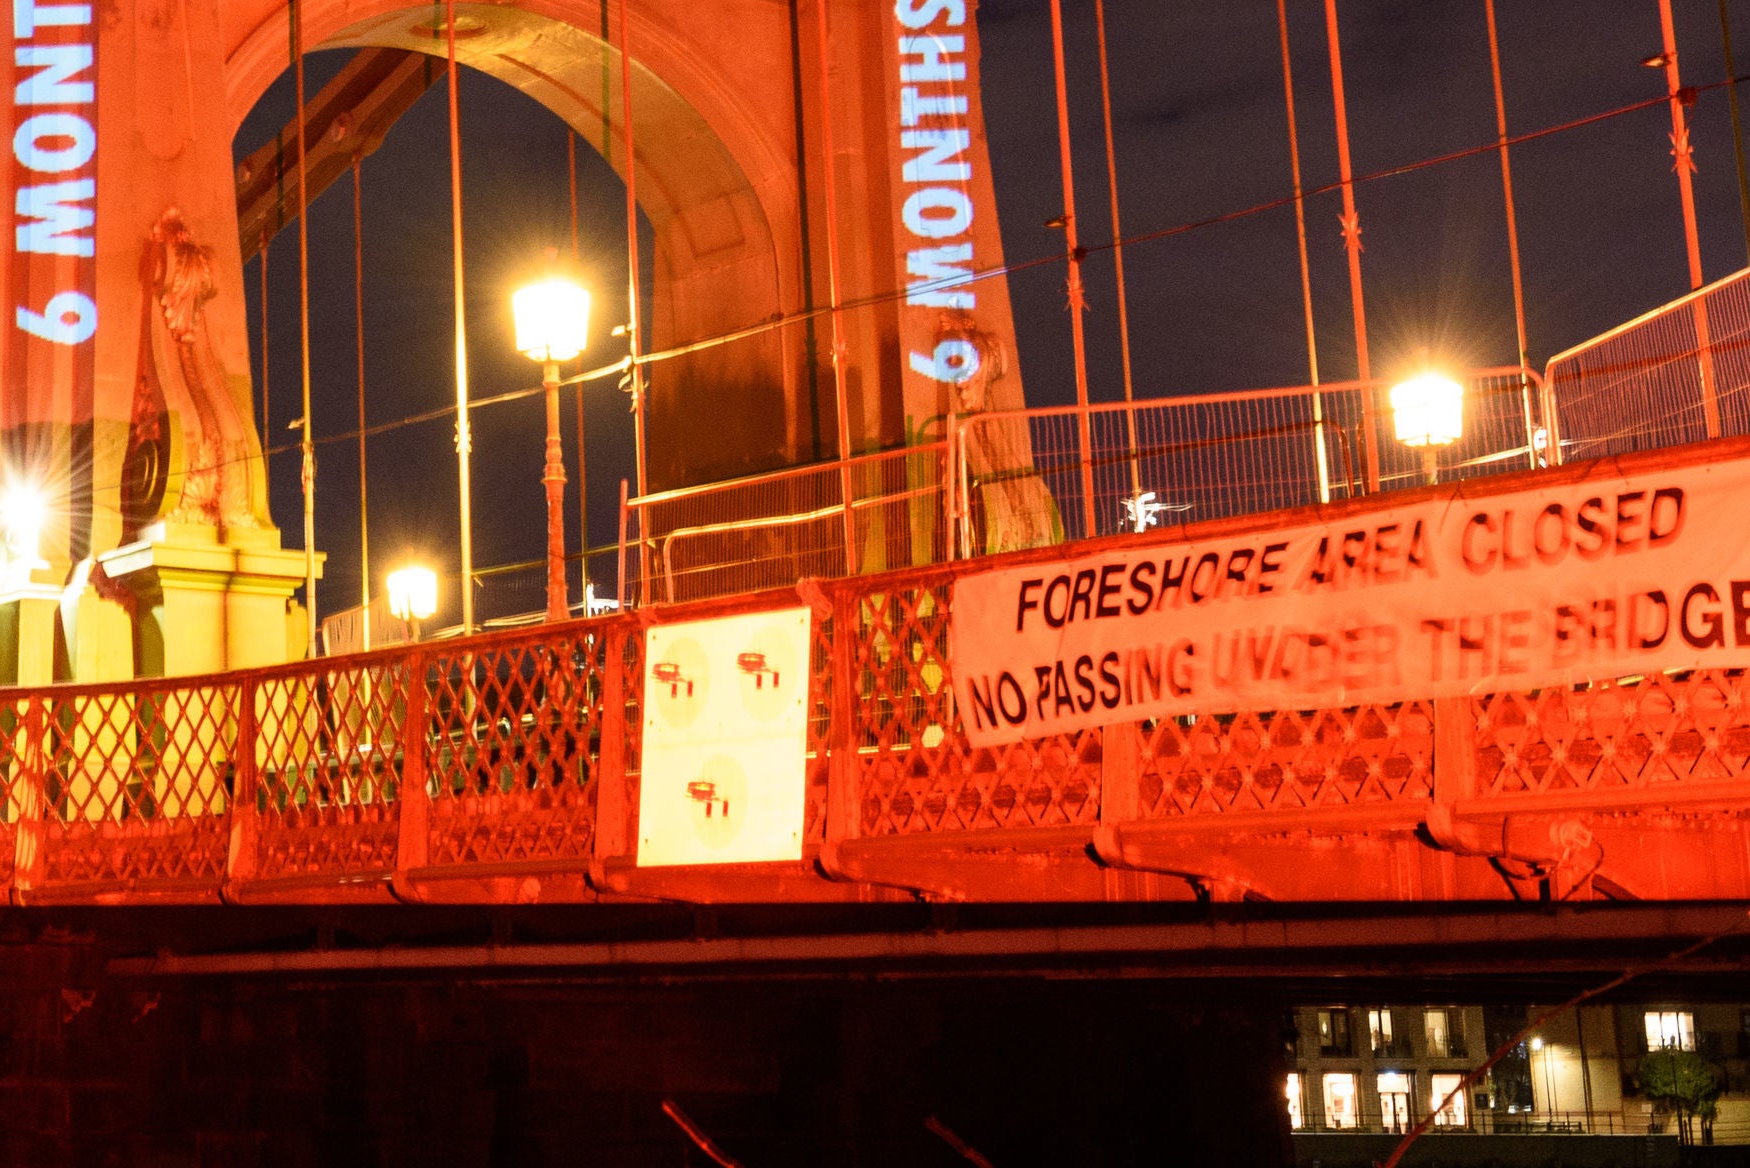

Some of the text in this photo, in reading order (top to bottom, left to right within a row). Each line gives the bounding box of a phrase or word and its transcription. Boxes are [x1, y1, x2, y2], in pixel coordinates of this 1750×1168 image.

[16, 291, 98, 346] 6
[909, 338, 981, 384] 6
[1016, 487, 1687, 632] FORESHORE AREA CLOSED
[967, 670, 1027, 731] NO
[1035, 637, 1194, 721] PASSING
[1420, 609, 1532, 682] THE
